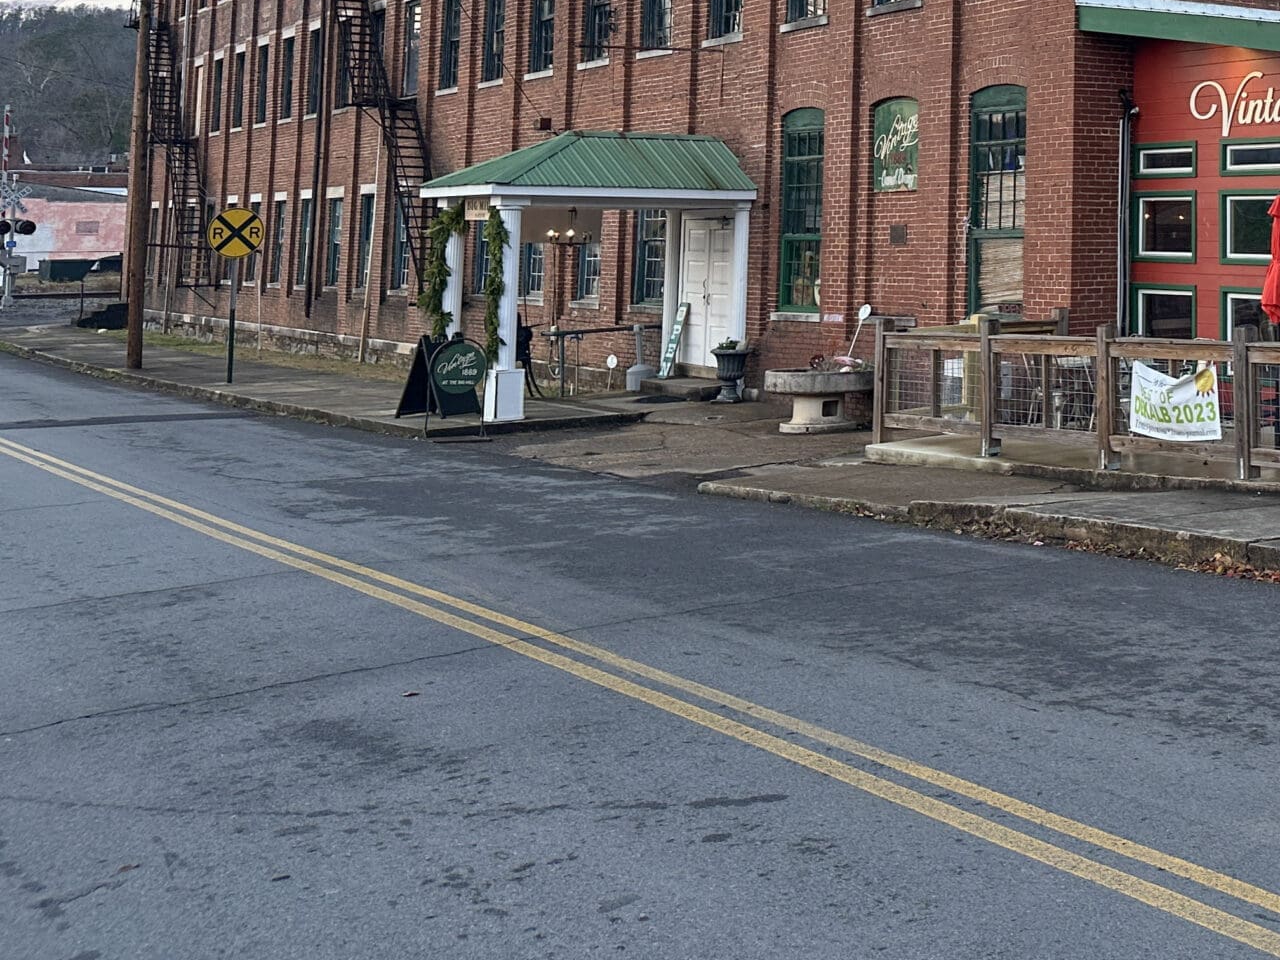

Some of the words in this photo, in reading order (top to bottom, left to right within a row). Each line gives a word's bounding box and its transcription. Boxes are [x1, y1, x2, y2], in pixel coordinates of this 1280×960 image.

[213, 227, 223, 240] R
[250, 226, 260, 239] R
[659, 306, 687, 377] OPEN
[437, 351, 478, 375] Vintage
[1159, 390, 1174, 405] OF
[1172, 401, 1217, 424] 2023
